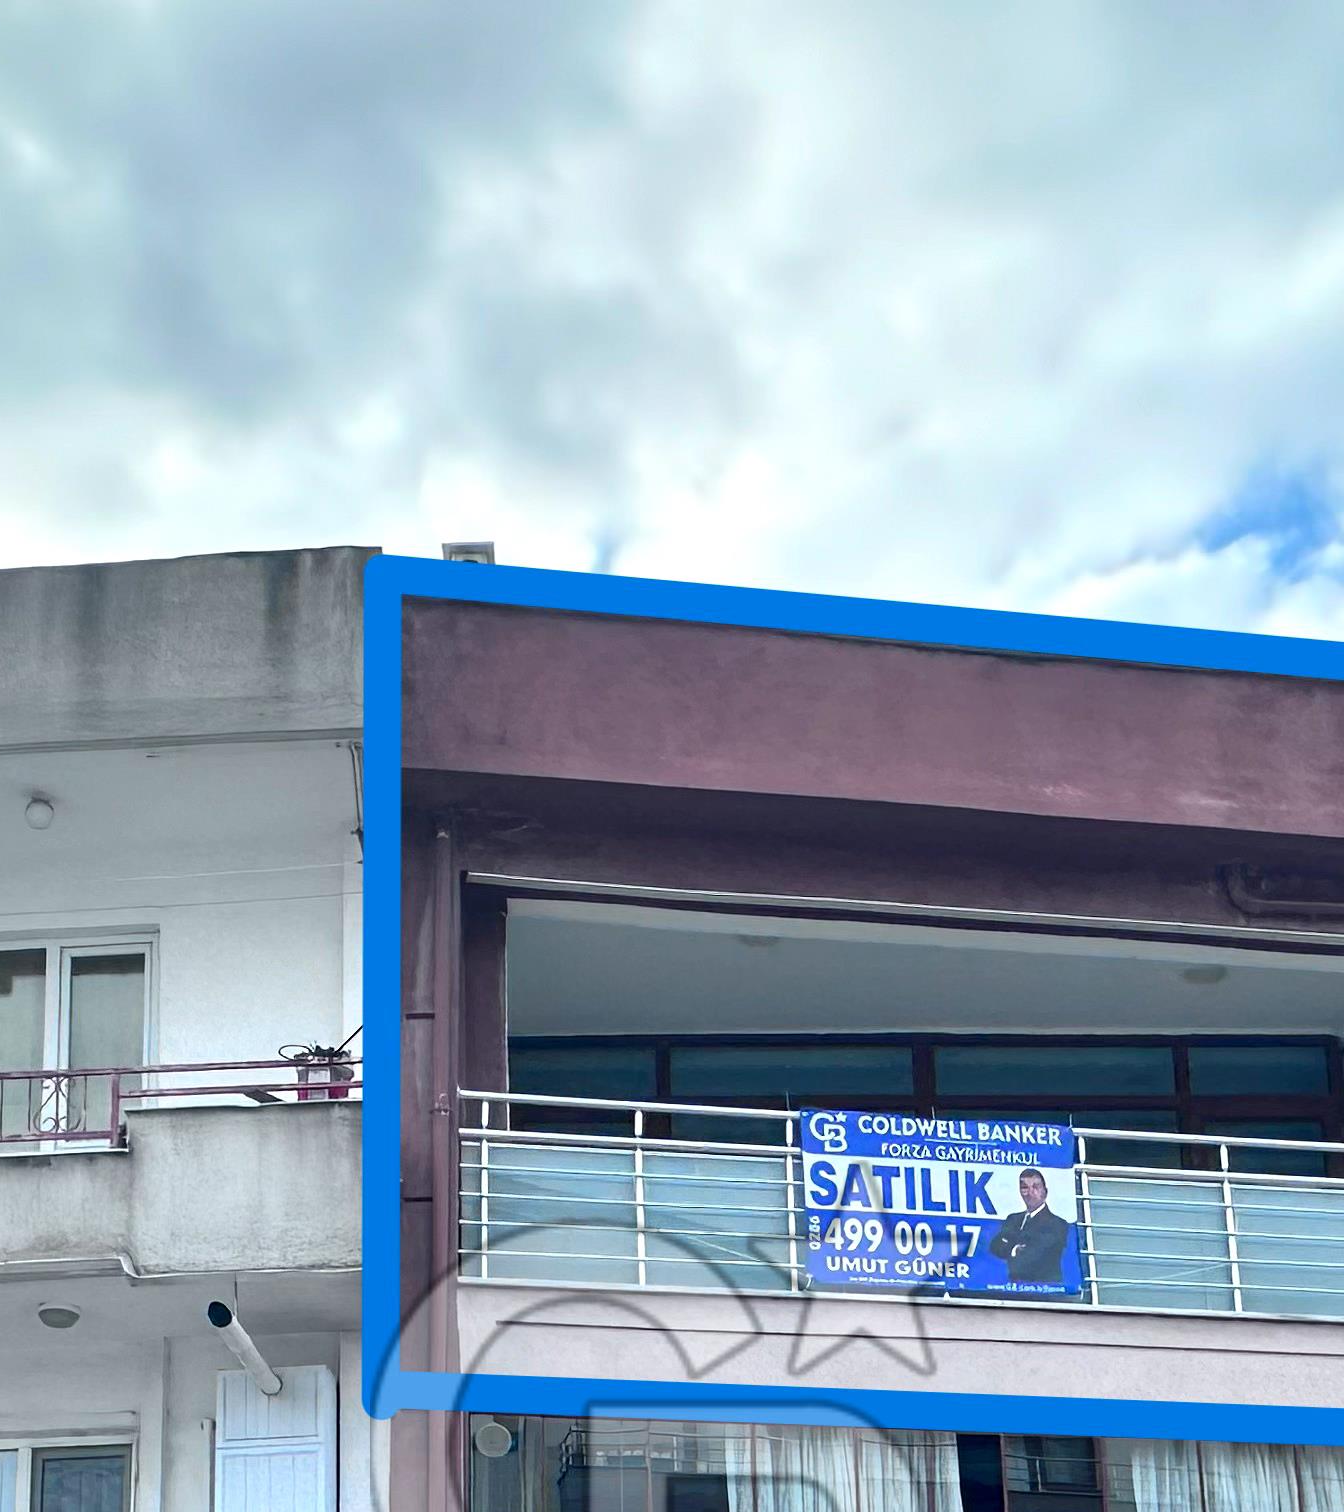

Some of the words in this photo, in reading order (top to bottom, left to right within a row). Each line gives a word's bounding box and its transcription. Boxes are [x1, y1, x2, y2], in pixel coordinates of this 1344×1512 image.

[858, 1115, 972, 1141] COLDWELL
[977, 1121, 1063, 1147] BANKER
[881, 1142, 933, 1159] FORZA
[809, 1160, 999, 1216] SATILIK
[824, 1217, 884, 1253] 499
[893, 1220, 934, 1256] 00
[945, 1223, 982, 1258] 17
[826, 1255, 889, 1275] UMUT
[894, 1257, 971, 1279] GÜNER
